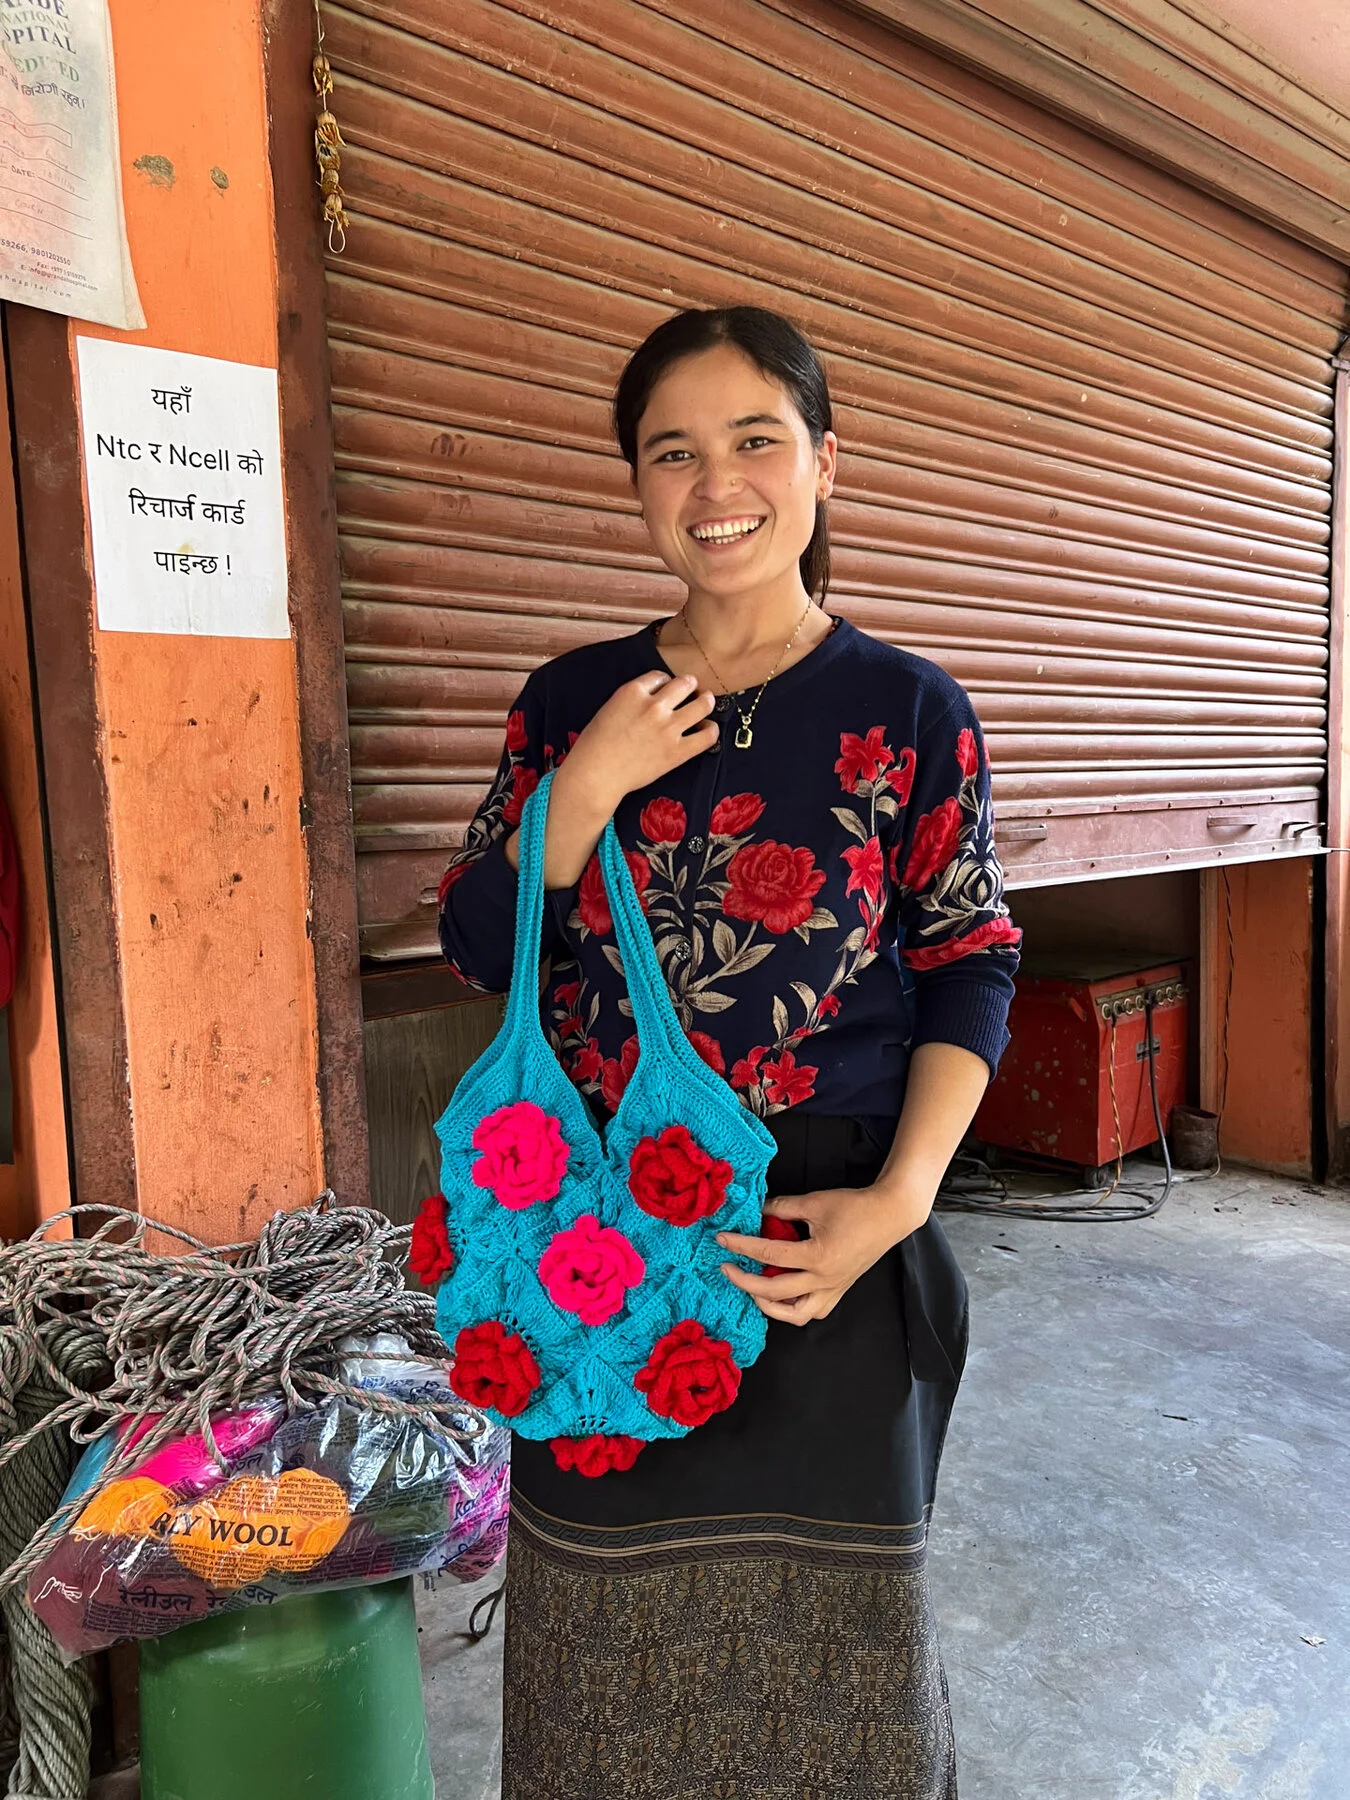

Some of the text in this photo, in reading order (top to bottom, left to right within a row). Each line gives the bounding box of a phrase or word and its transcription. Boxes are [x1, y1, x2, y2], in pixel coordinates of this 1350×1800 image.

[151, 386, 192, 415] यहाँ
[97, 433, 264, 475] Ntc र Ncell को
[128, 488, 246, 525] रिचार्ज कार्ड
[154, 551, 232, 575] पाइन्छ !
[209, 1518, 294, 1546] WOOL
